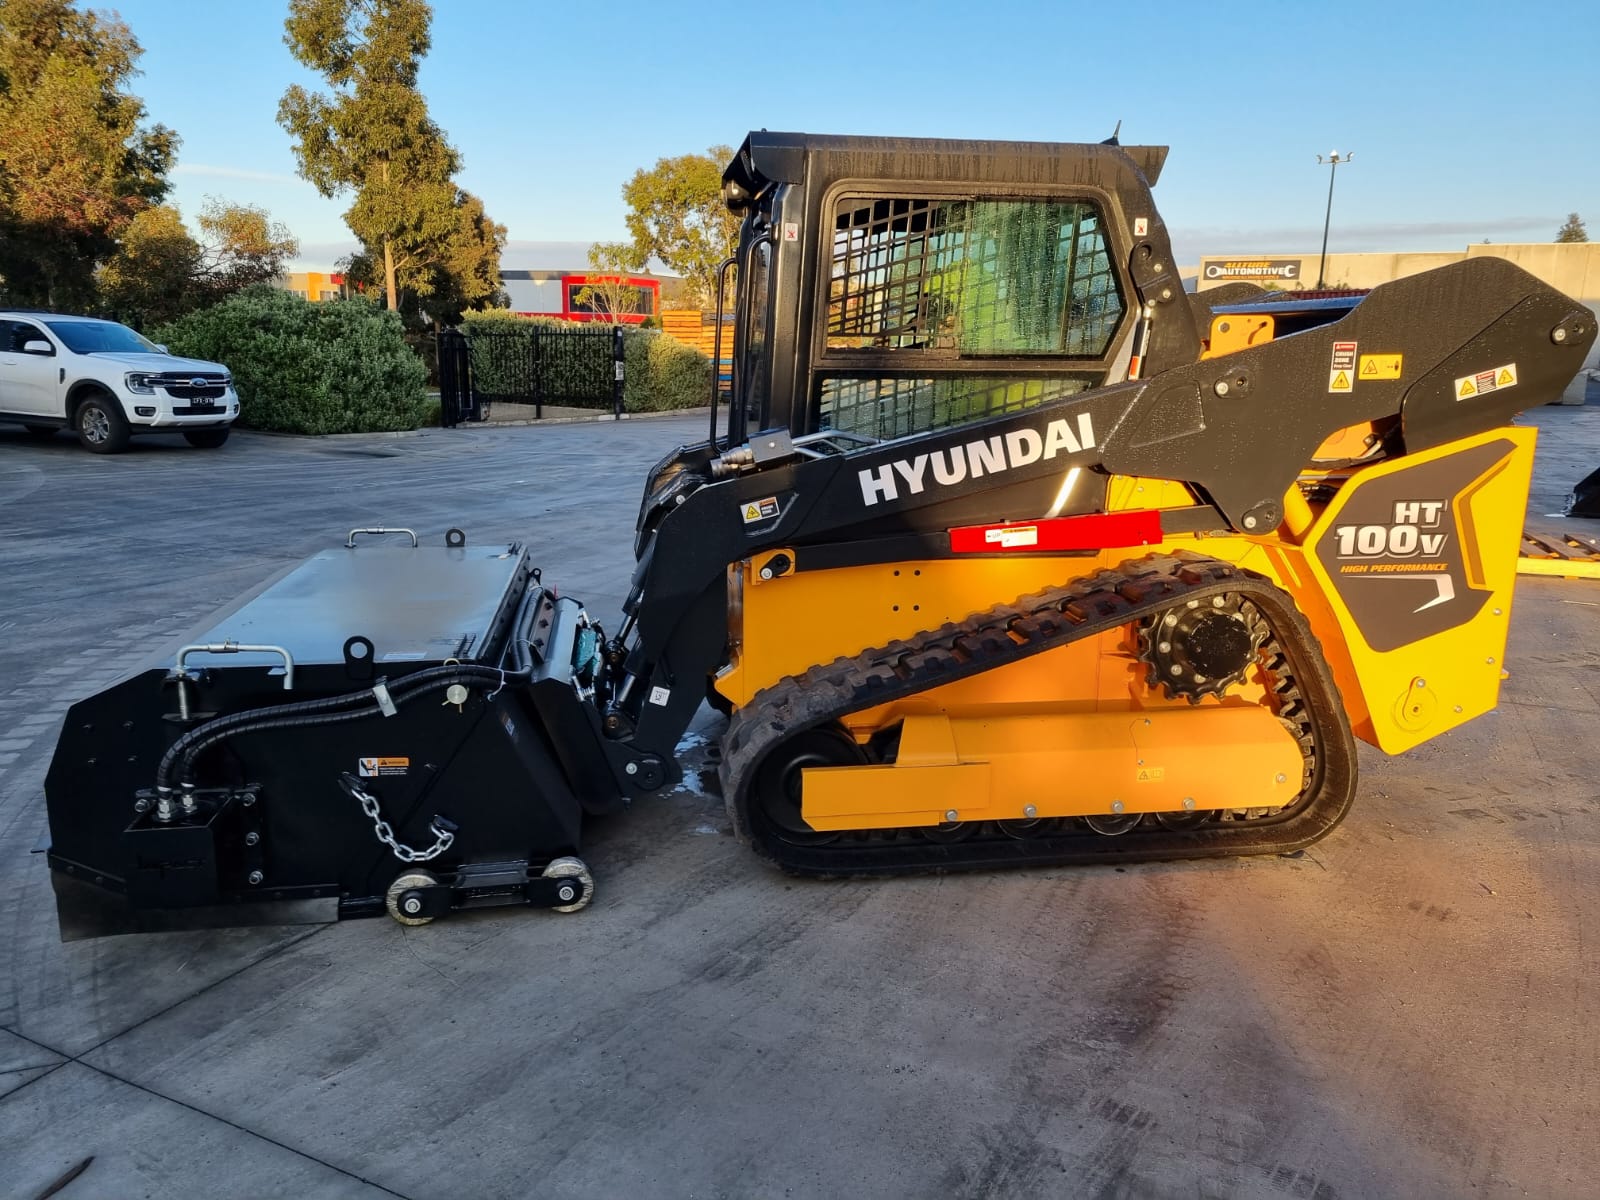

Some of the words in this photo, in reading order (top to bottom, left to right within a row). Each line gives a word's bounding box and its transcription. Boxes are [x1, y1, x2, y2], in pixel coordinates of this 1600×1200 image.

[1220, 267, 1284, 276] AUTOMOTIVE
[858, 412, 1096, 506] HYUNDAI
[1395, 502, 1443, 524] HT
[1340, 565, 1368, 573] HIGH
[1370, 563, 1448, 573] PERFORMANCE
